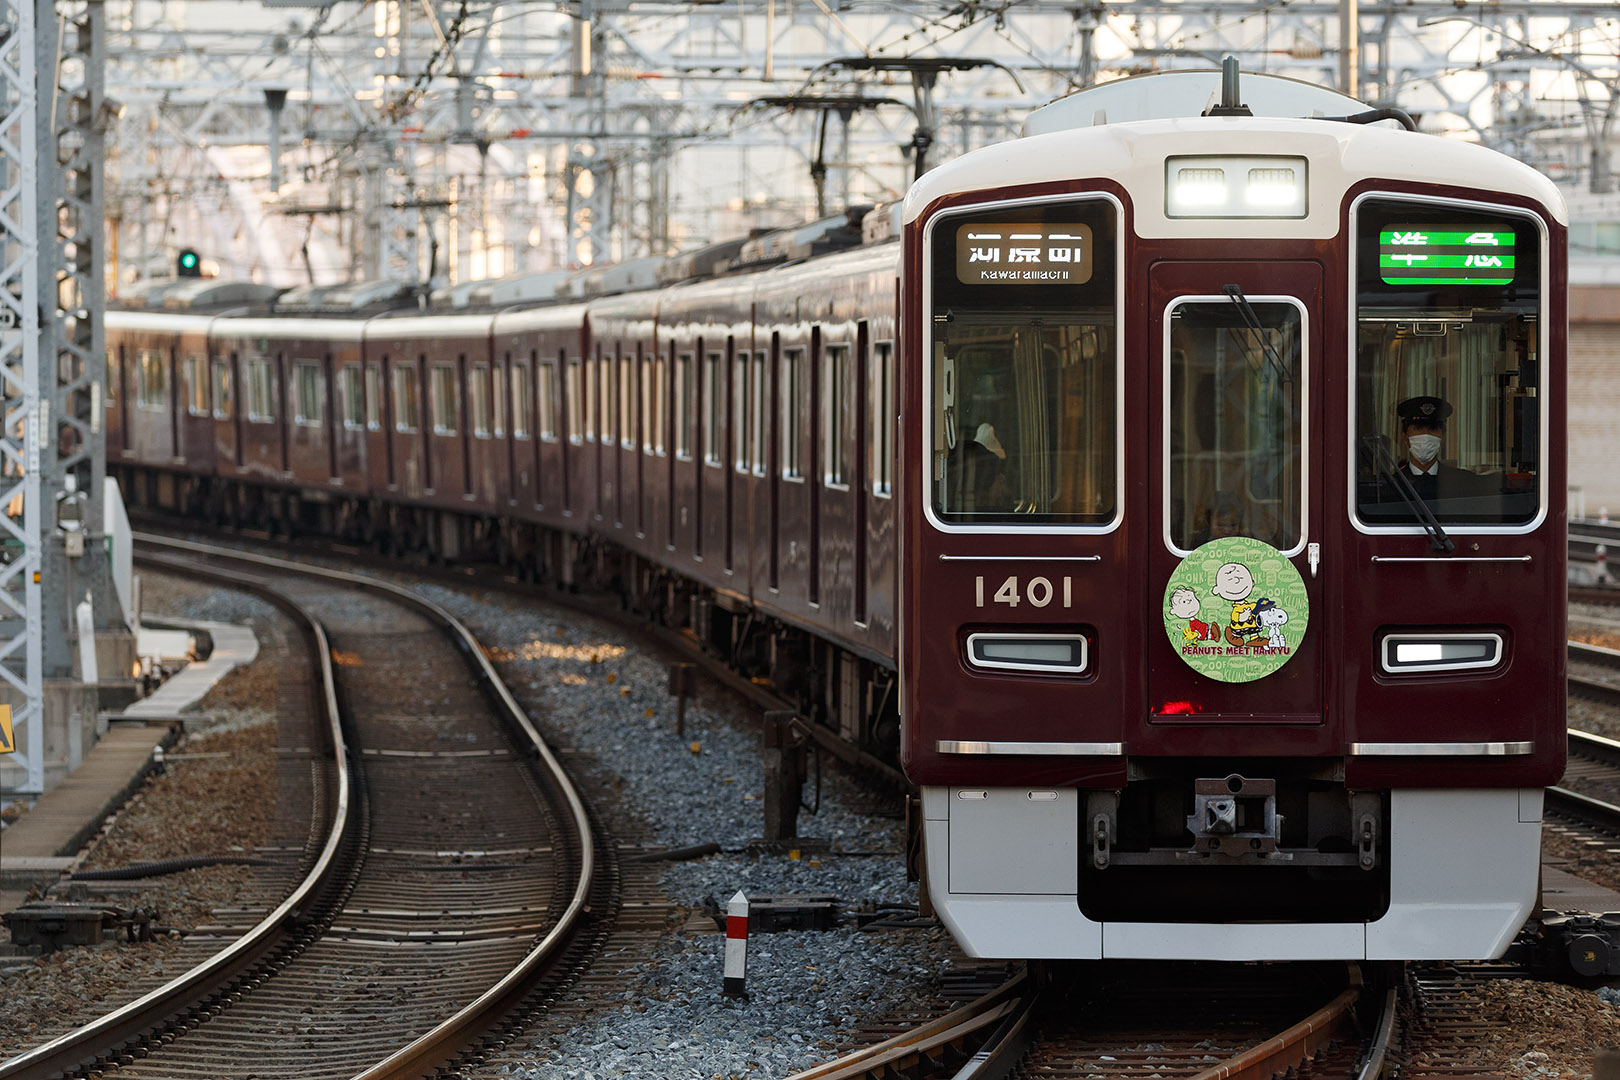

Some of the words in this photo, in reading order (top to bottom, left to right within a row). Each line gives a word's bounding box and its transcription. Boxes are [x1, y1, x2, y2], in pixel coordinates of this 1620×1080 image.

[975, 575, 1072, 608] 1401
[1182, 646, 1223, 655] PEANUTS
[1225, 646, 1250, 655] MEET
[1253, 646, 1290, 655] HANKYU
